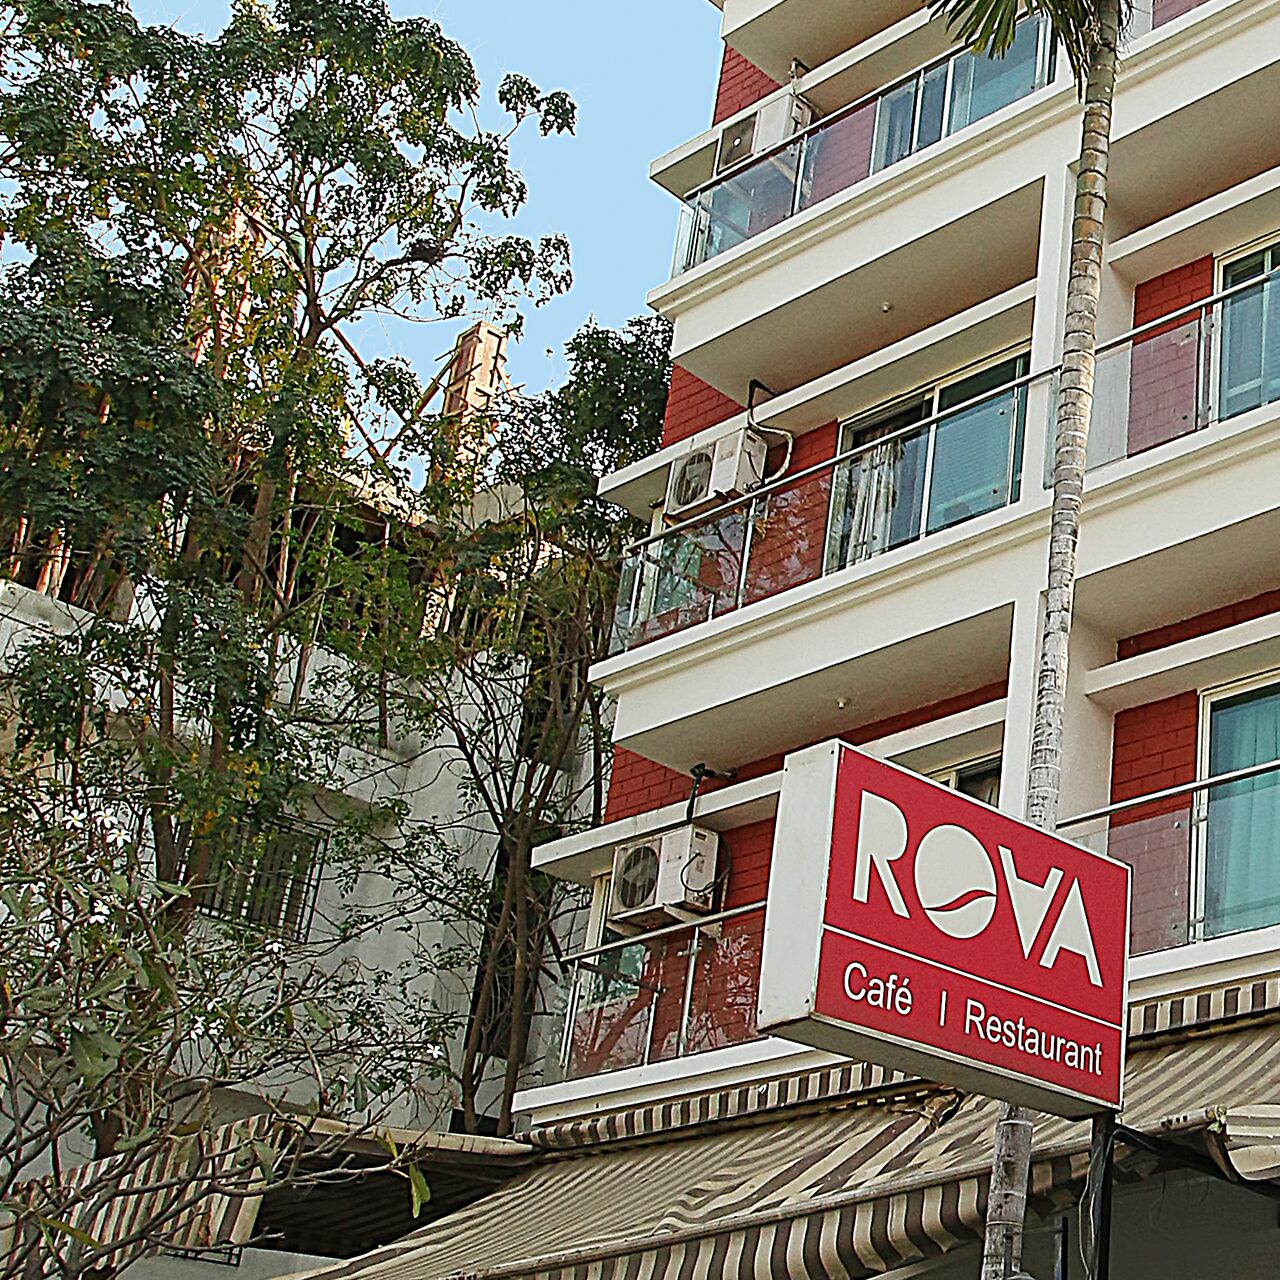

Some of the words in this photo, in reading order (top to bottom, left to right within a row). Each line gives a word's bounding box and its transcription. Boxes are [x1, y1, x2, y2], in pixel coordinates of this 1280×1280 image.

[852, 789, 1104, 988] ROVA
[842, 961, 913, 1016] Café
[964, 998, 1103, 1076] Restaurant
